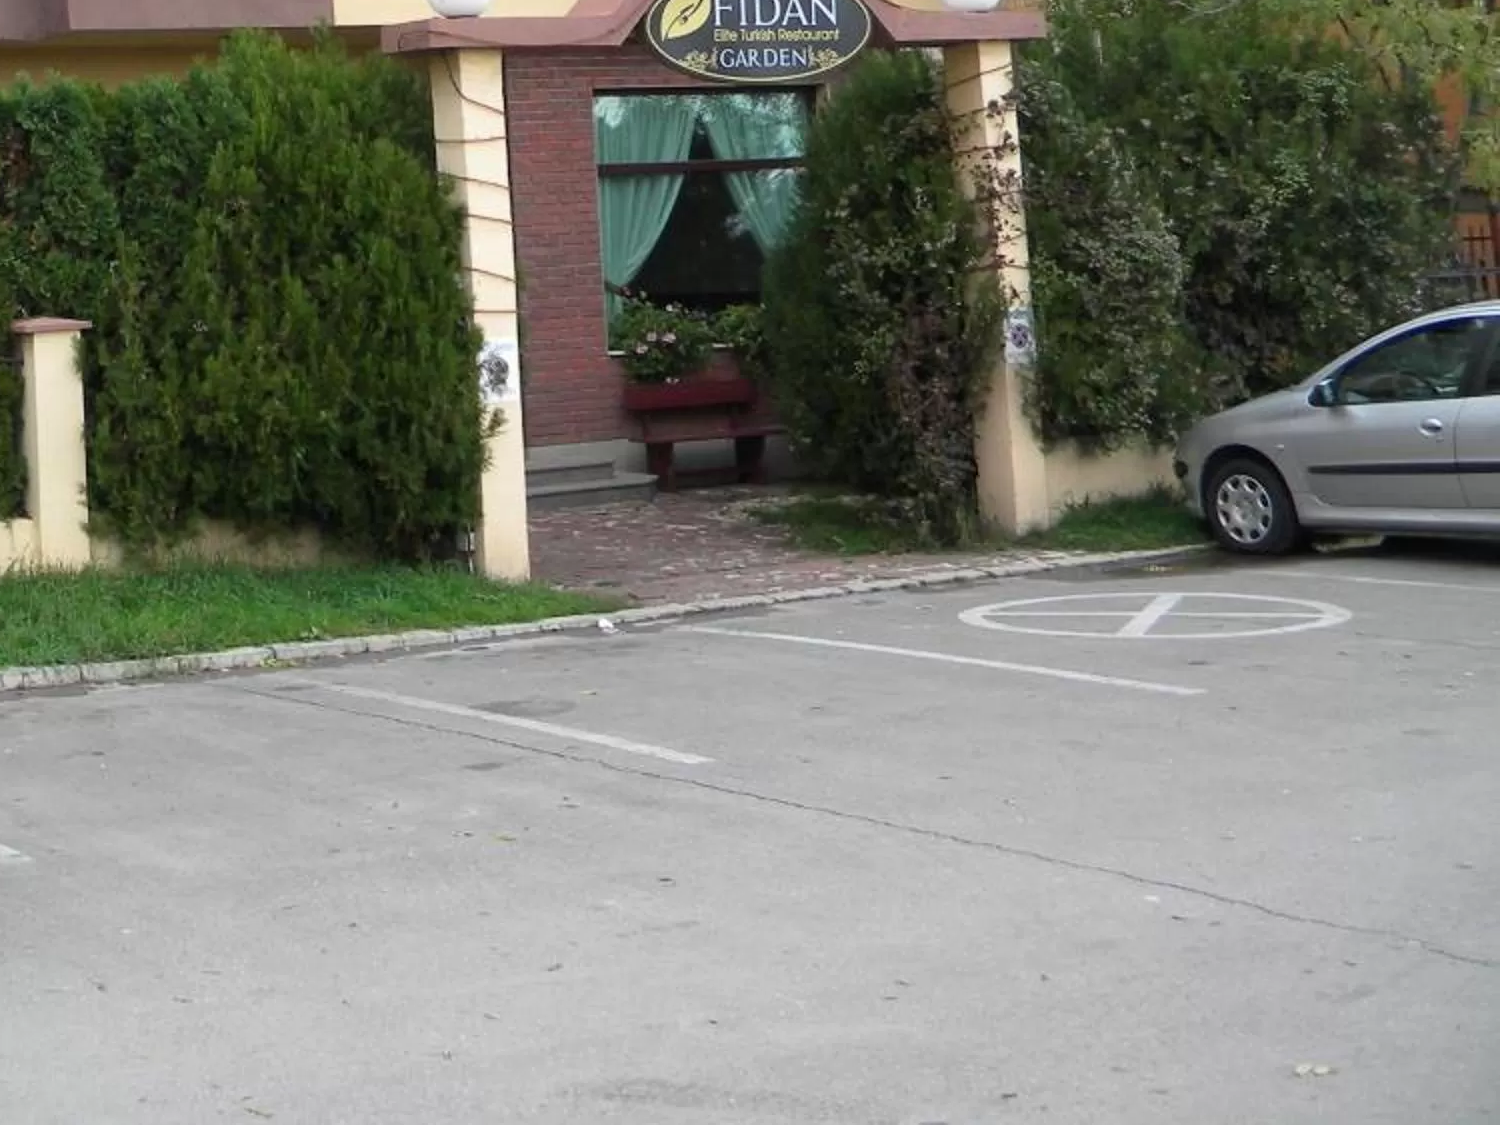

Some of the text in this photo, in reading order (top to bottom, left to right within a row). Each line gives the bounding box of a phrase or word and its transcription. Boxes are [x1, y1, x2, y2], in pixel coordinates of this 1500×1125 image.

[713, 28, 840, 42] Elite Turkish Restaurant
[720, 48, 808, 68] GARDEN
